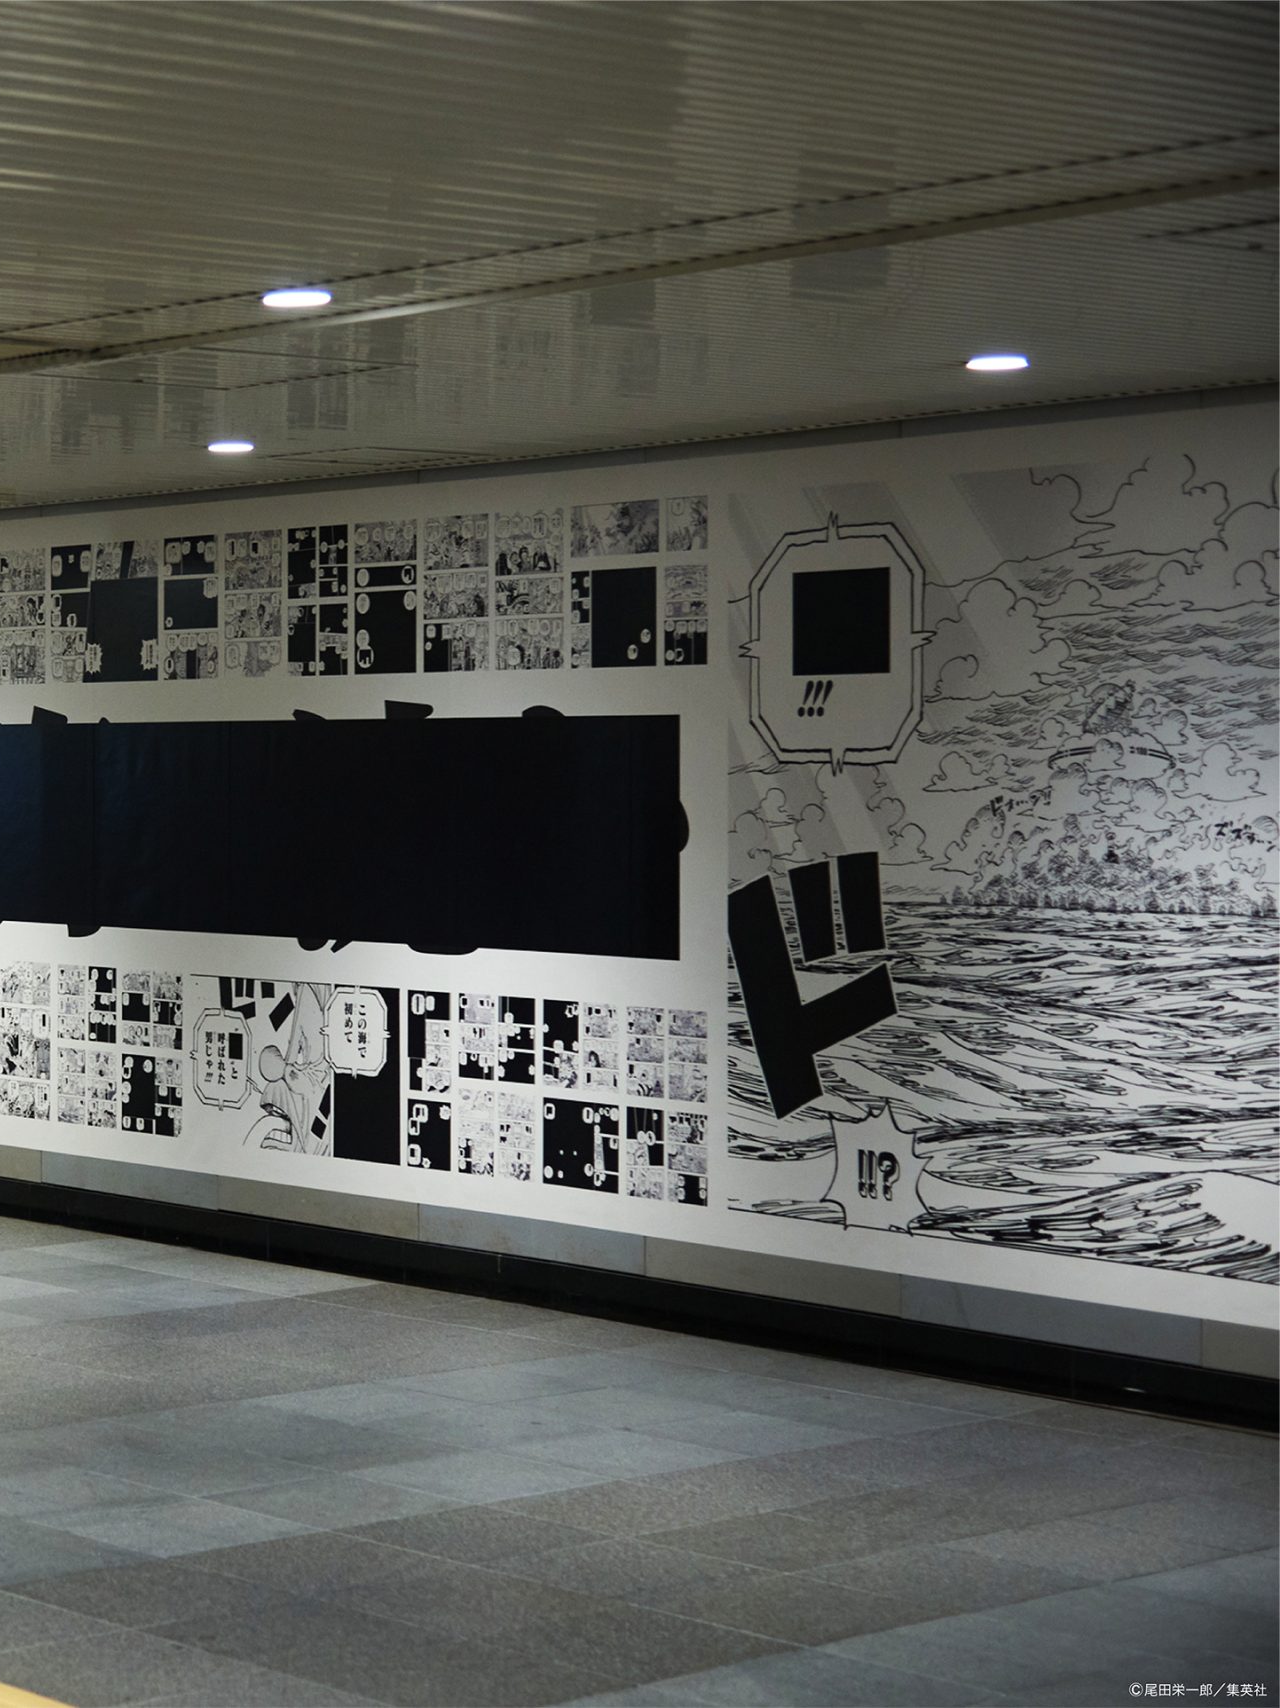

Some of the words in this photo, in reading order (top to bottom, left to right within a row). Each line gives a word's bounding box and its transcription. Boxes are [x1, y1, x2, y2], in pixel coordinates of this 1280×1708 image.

[344, 1001, 354, 1044] 初めて
[357, 1004, 367, 1059] この海で
[217, 1032, 226, 1085] 呼ばれた
